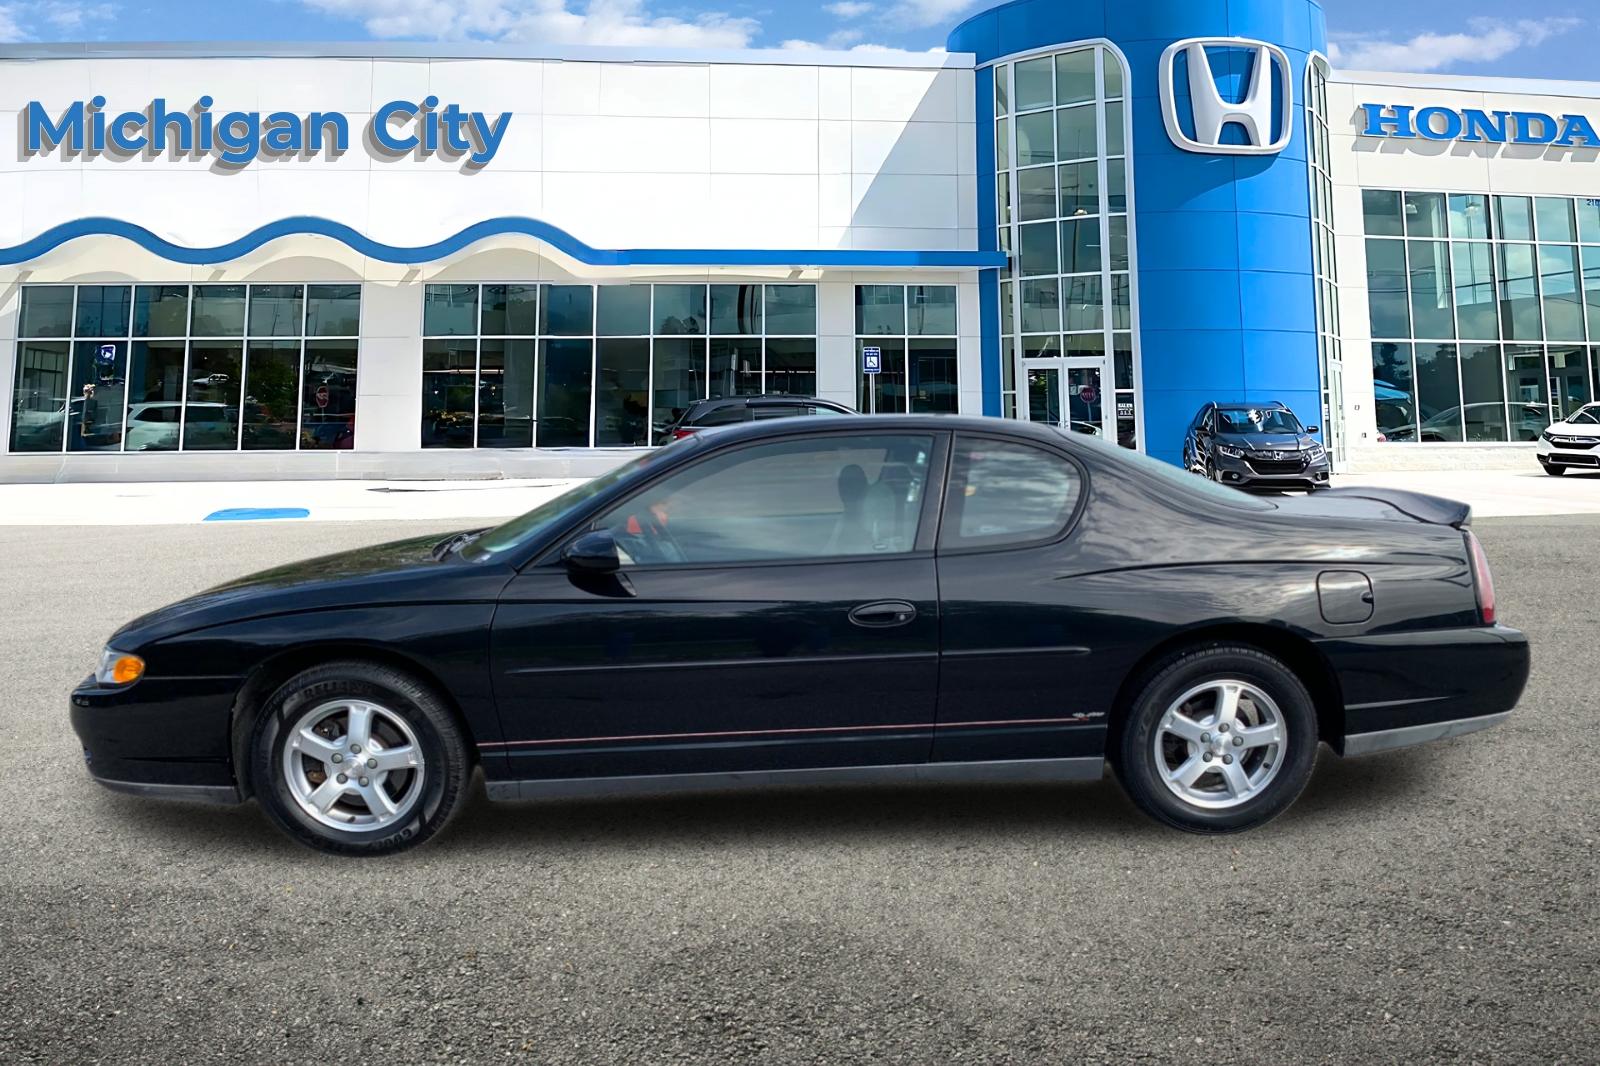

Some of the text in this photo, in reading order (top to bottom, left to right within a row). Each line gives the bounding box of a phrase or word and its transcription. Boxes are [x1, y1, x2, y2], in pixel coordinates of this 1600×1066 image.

[27, 95, 513, 165] Michigan City
[1361, 102, 1600, 147] HONDA
